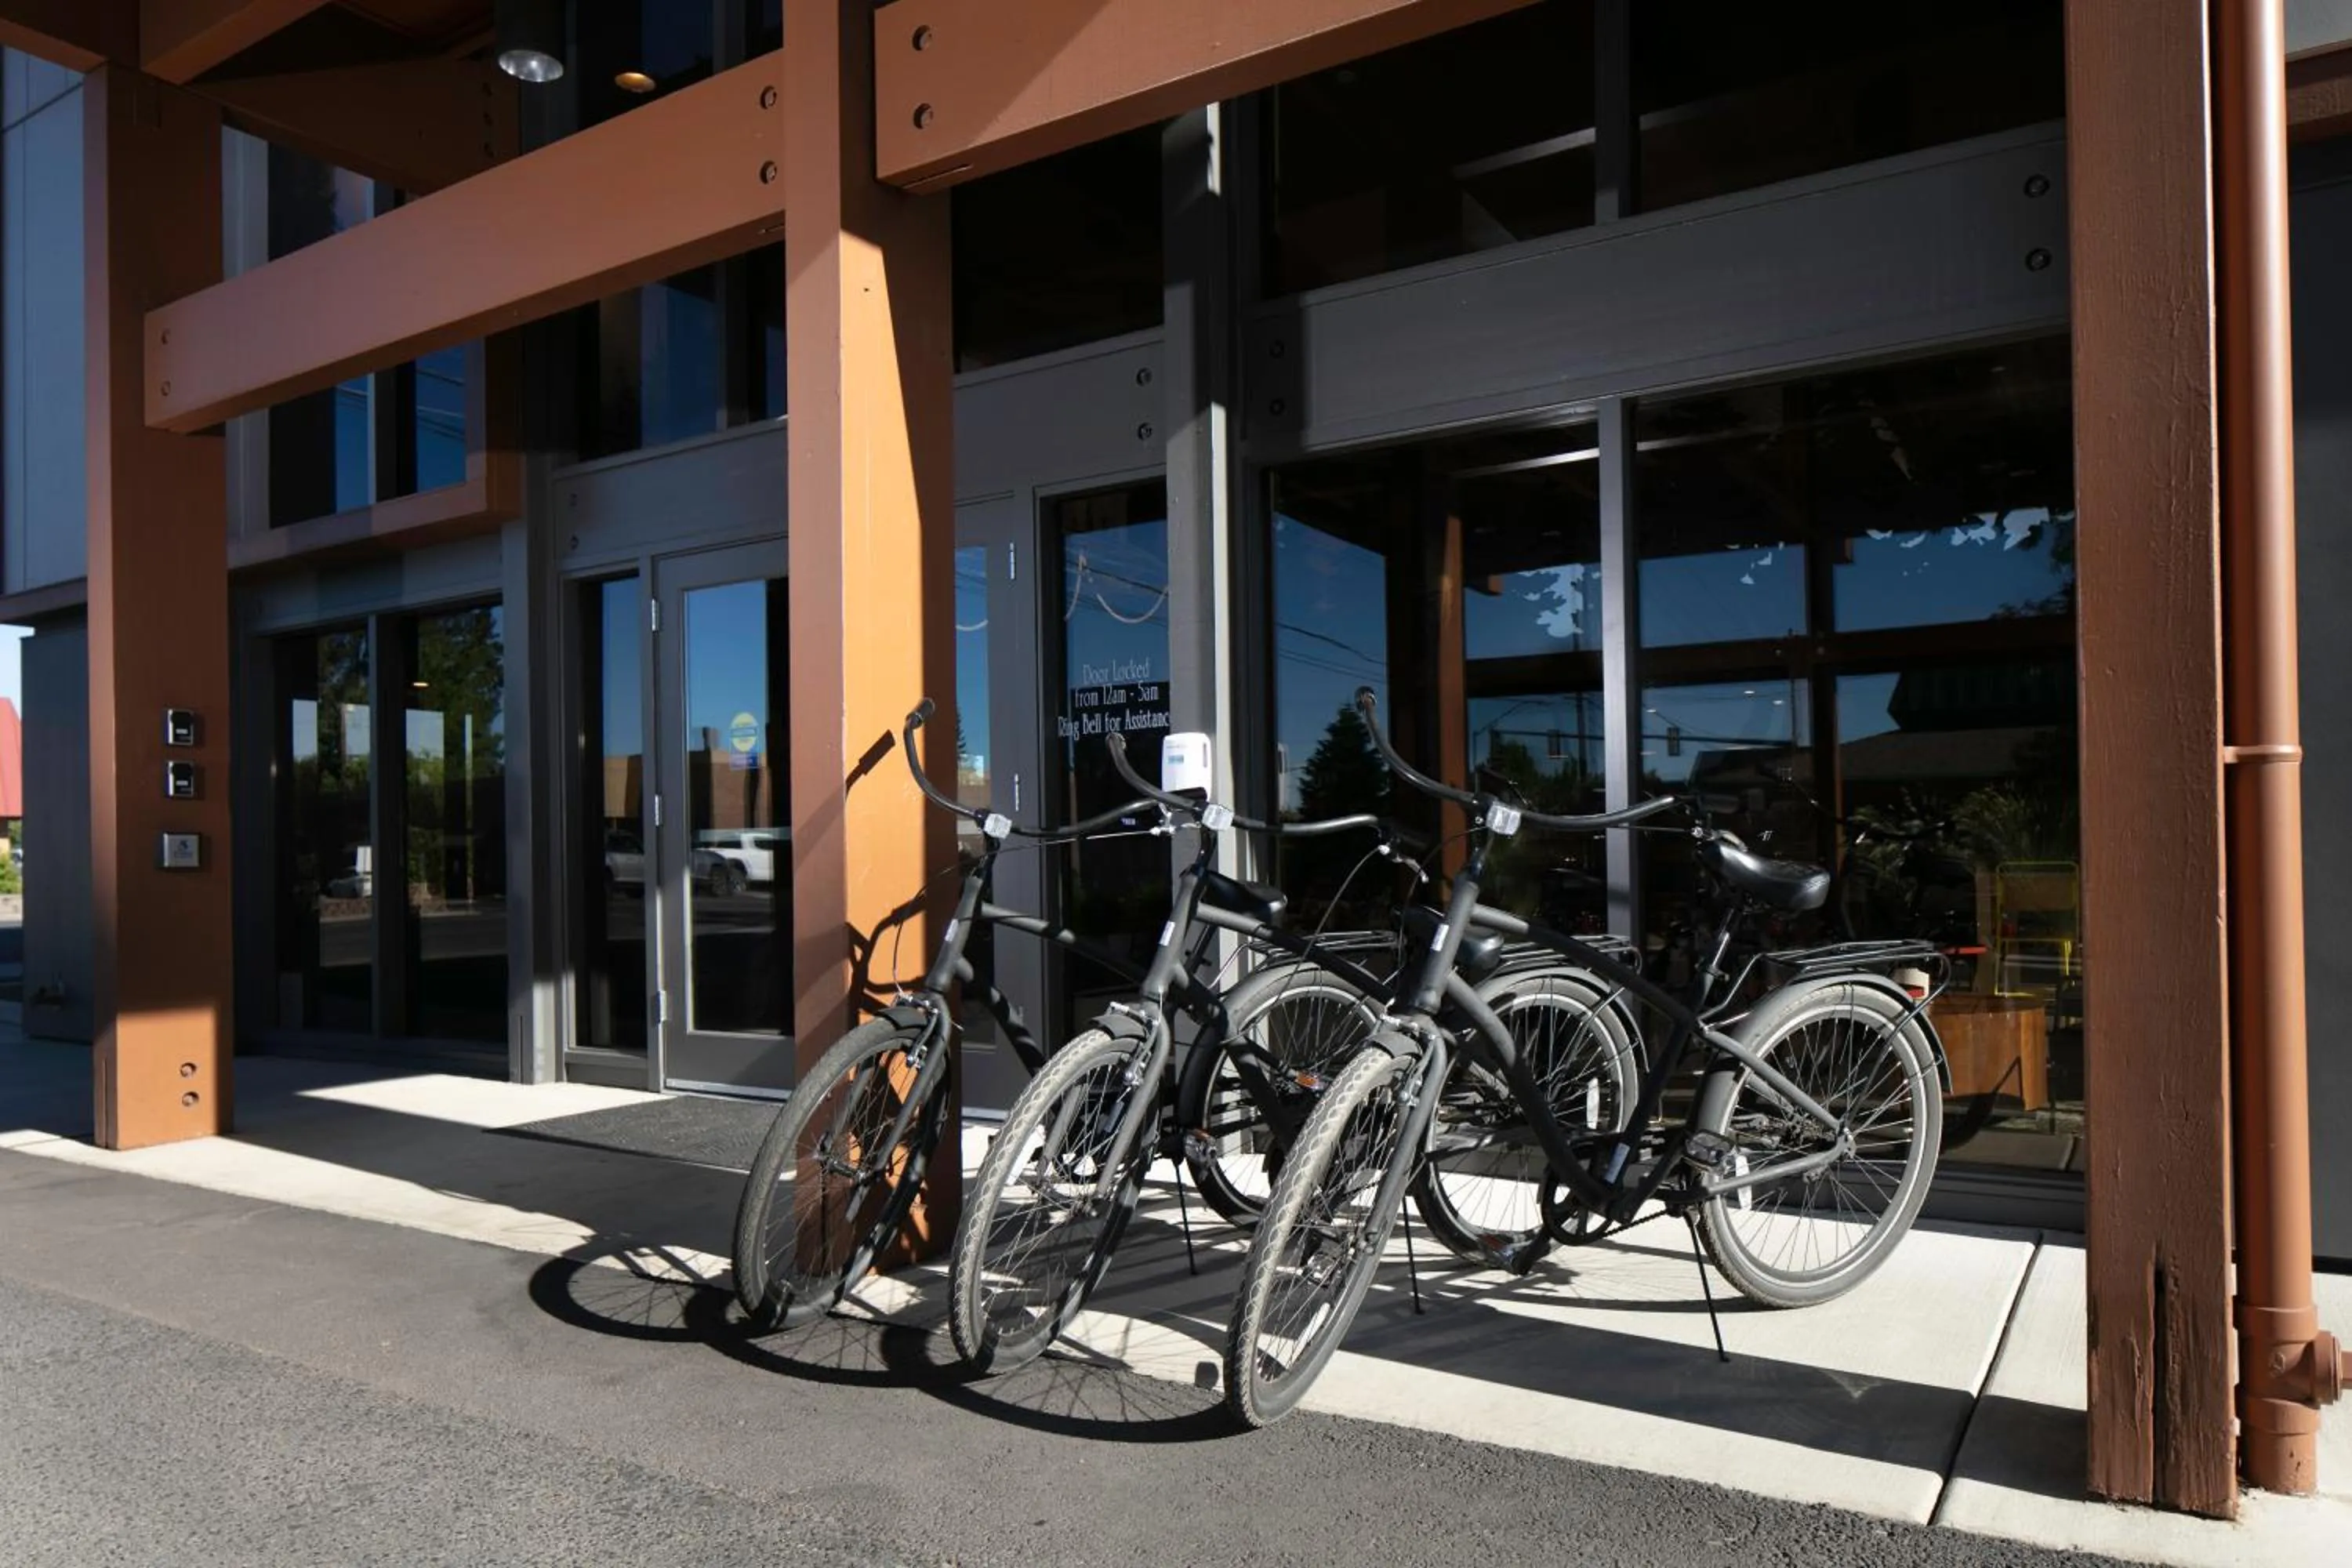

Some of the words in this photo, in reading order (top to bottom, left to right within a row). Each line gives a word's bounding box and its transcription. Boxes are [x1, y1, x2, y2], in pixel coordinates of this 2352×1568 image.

[1083, 664, 1109, 684] Door
[1112, 657, 1149, 681] Locked
[1075, 688, 1098, 708] from
[1103, 684, 1127, 705] 12am
[1138, 681, 1159, 702] 5am
[1082, 713, 1102, 734] bell
[1105, 712, 1122, 731] for
[1125, 709, 1170, 730] Assistanc
